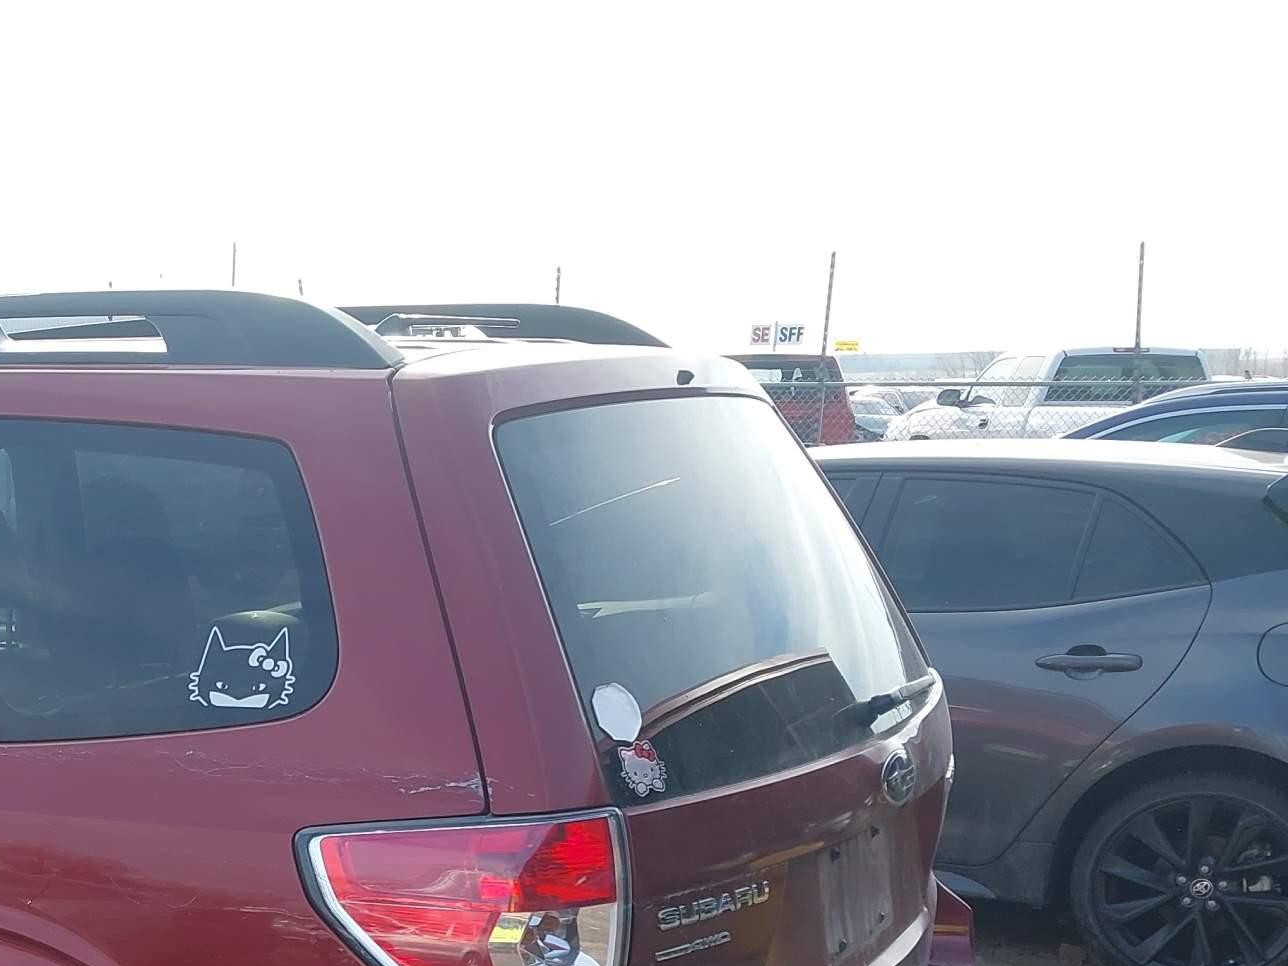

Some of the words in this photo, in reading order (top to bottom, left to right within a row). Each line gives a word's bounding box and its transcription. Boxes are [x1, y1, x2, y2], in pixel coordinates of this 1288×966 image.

[752, 326, 770, 343] SE
[779, 326, 805, 343] SFF
[657, 880, 770, 930] SUBARU
